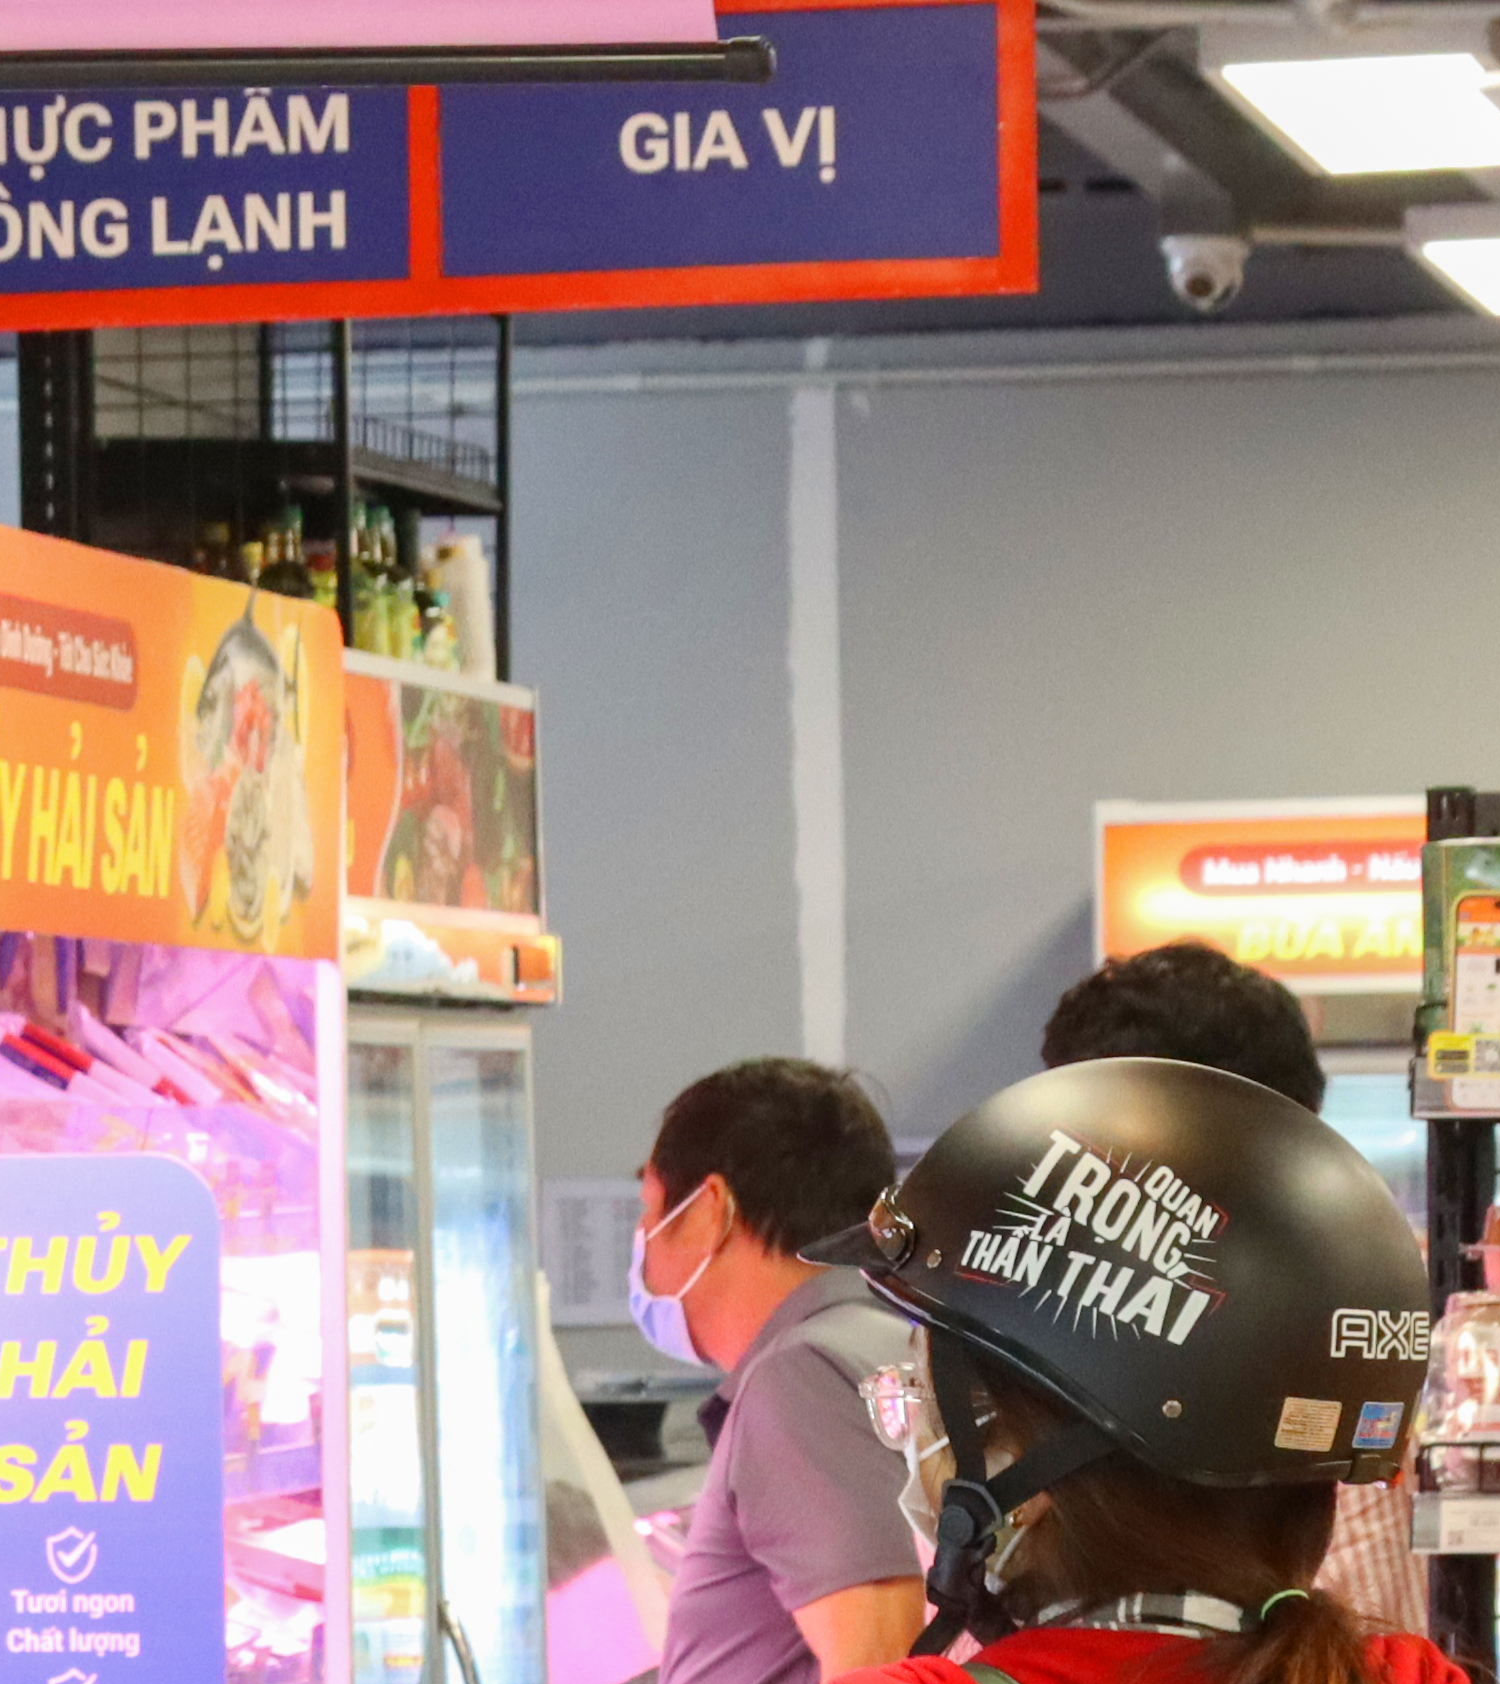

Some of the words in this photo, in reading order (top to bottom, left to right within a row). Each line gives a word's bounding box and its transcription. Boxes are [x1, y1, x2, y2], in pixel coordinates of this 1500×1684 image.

[618, 108, 748, 175] GIA
[763, 105, 838, 185] VỊ
[151, 191, 349, 271] LẠNH
[28, 721, 96, 890] HẢI
[101, 733, 175, 899] SẢN
[1022, 1129, 1191, 1275] TRỌNG
[1027, 1205, 1073, 1248] LÀ
[1143, 1164, 1220, 1239] QUAN
[6, 1625, 65, 1653] Chất
[69, 1626, 141, 1658] lượng
[10, 1588, 67, 1614] Tươi
[72, 1593, 136, 1619] ngon
